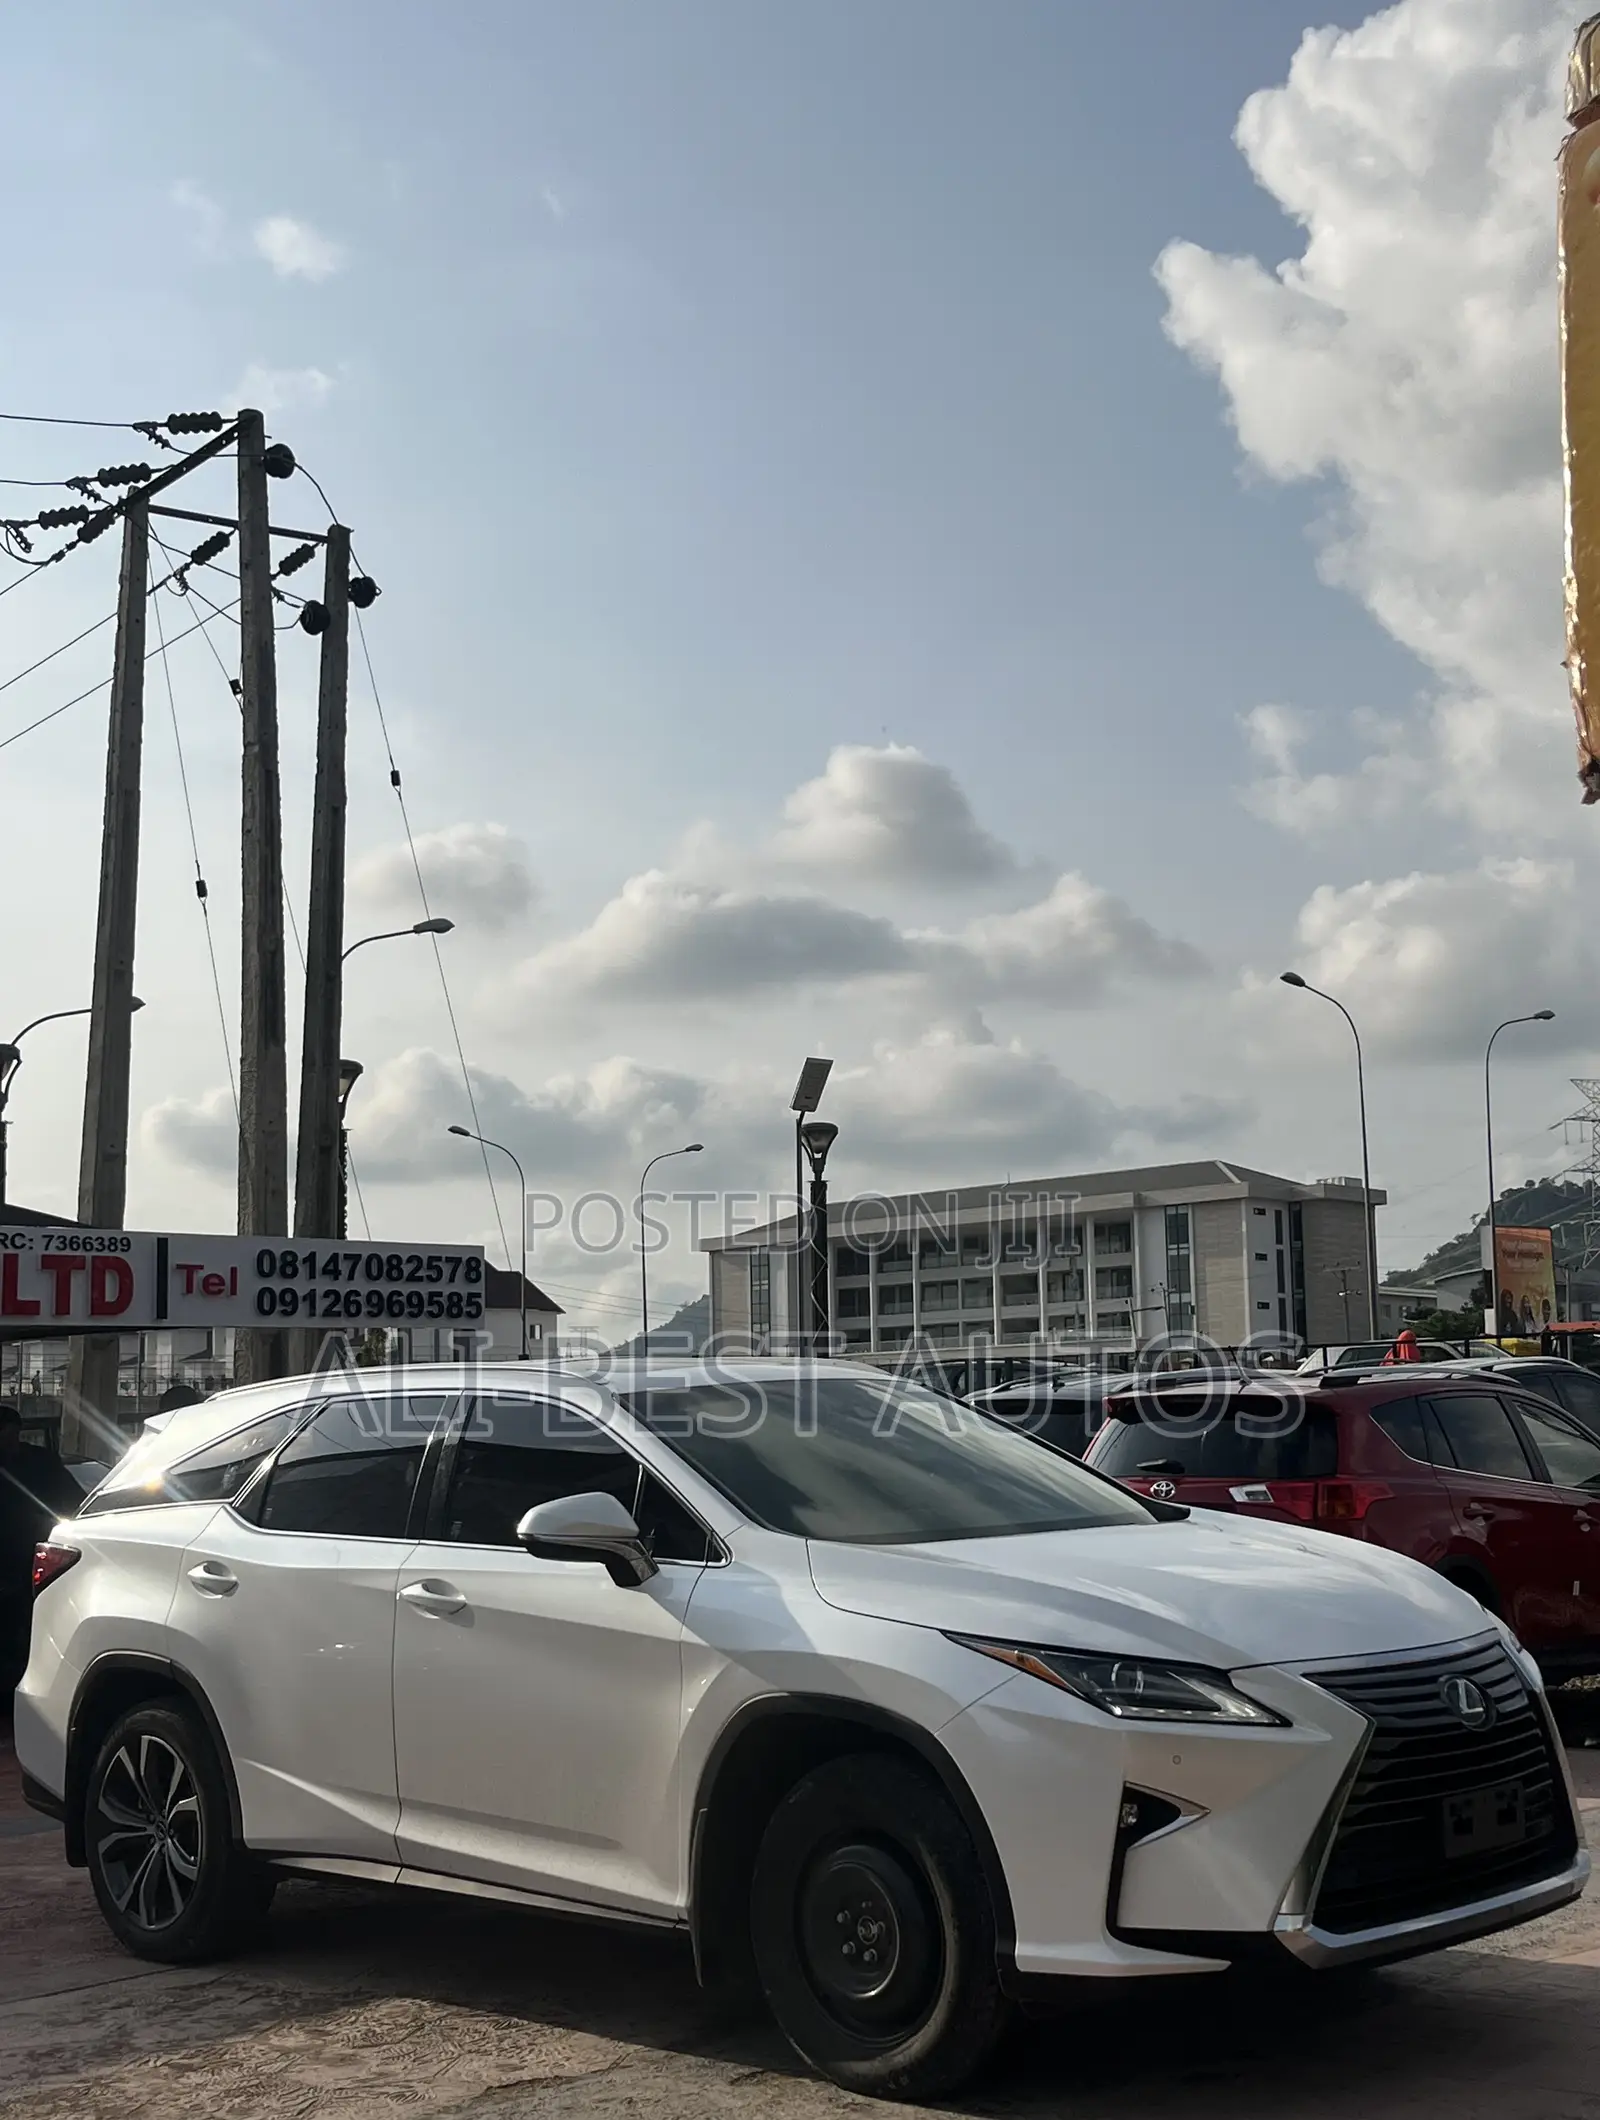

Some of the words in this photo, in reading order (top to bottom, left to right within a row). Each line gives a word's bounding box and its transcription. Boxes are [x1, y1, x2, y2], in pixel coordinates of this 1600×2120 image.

[42, 1234, 131, 1252] 7366389
[176, 1264, 237, 1296] Tel
[257, 1249, 482, 1283] 08147082578
[1, 1253, 134, 1315] LTD
[257, 1287, 482, 1318] 09126969585
